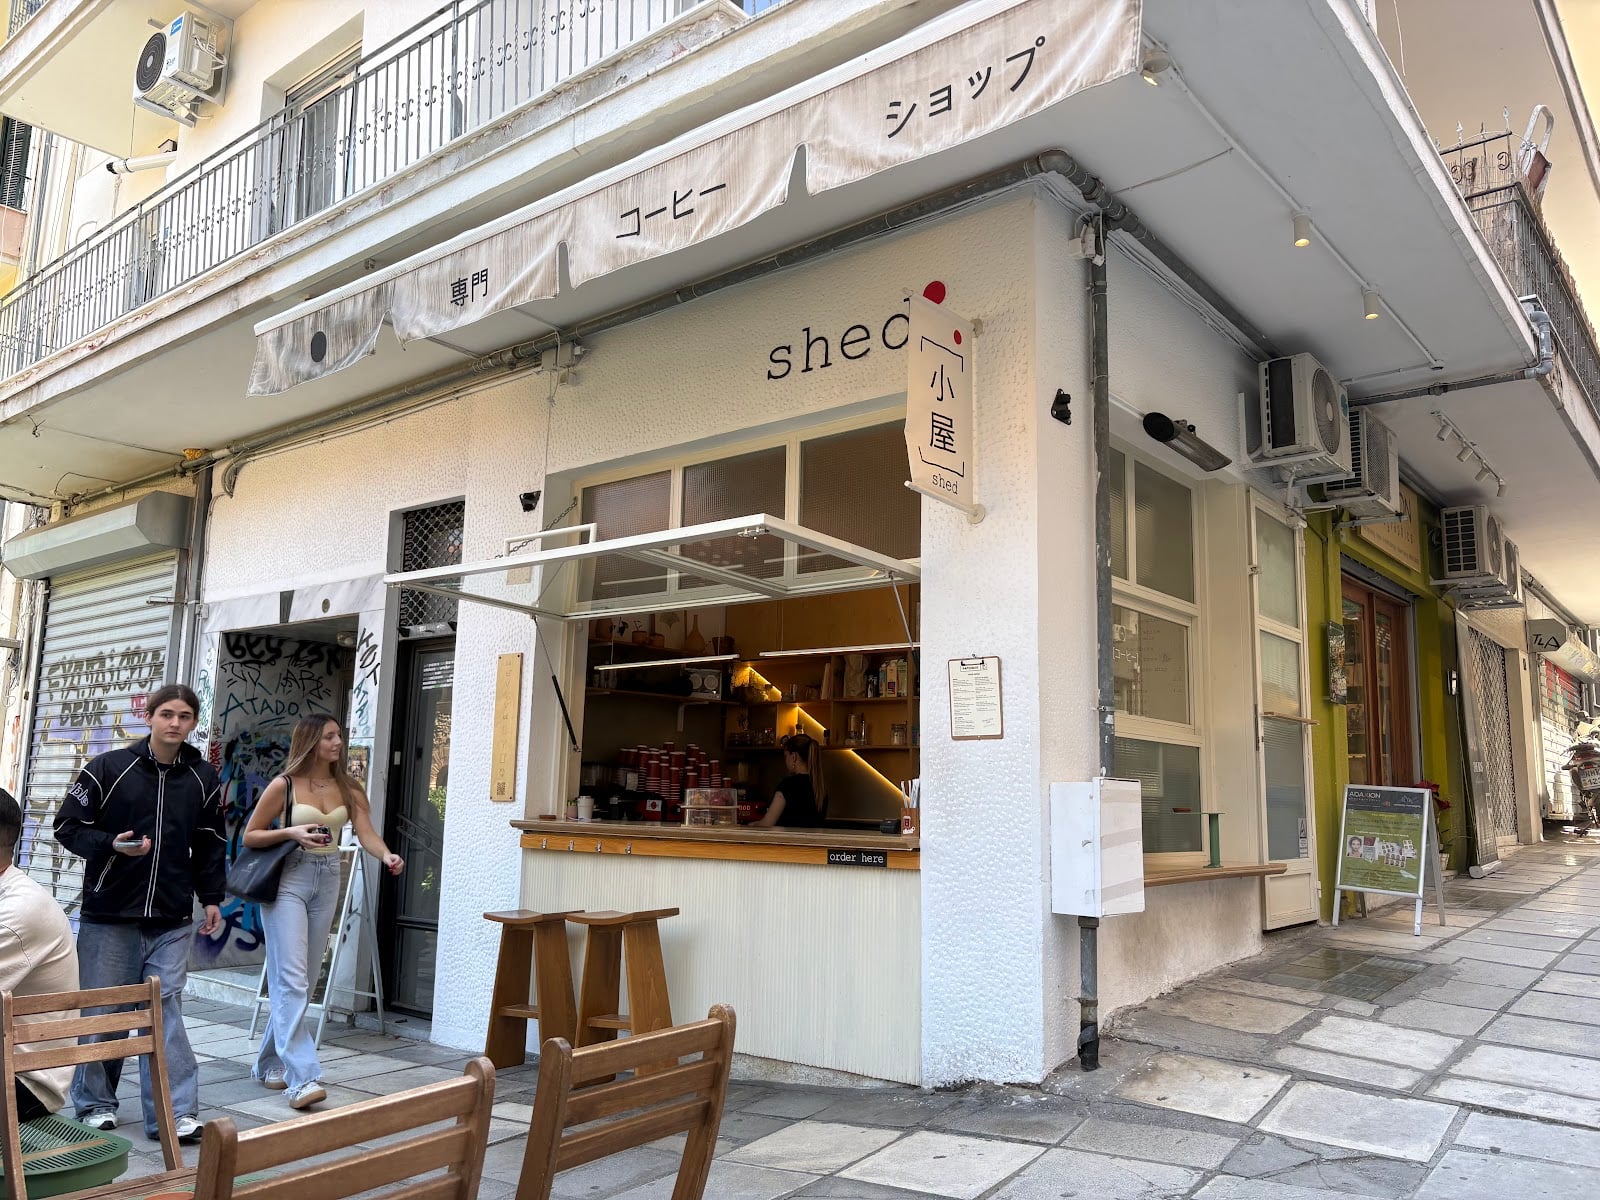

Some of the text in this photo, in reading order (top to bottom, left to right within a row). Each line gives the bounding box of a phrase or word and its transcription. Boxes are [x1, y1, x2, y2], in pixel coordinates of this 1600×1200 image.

[886, 35, 1046, 138] ショップ
[616, 183, 726, 239] コーヒー
[450, 268, 489, 307] 専門
[768, 297, 911, 380] shed
[930, 364, 957, 454] 小屋
[932, 473, 958, 495] shed
[1532, 633, 1560, 649] TLA
[829, 852, 884, 864] order here
